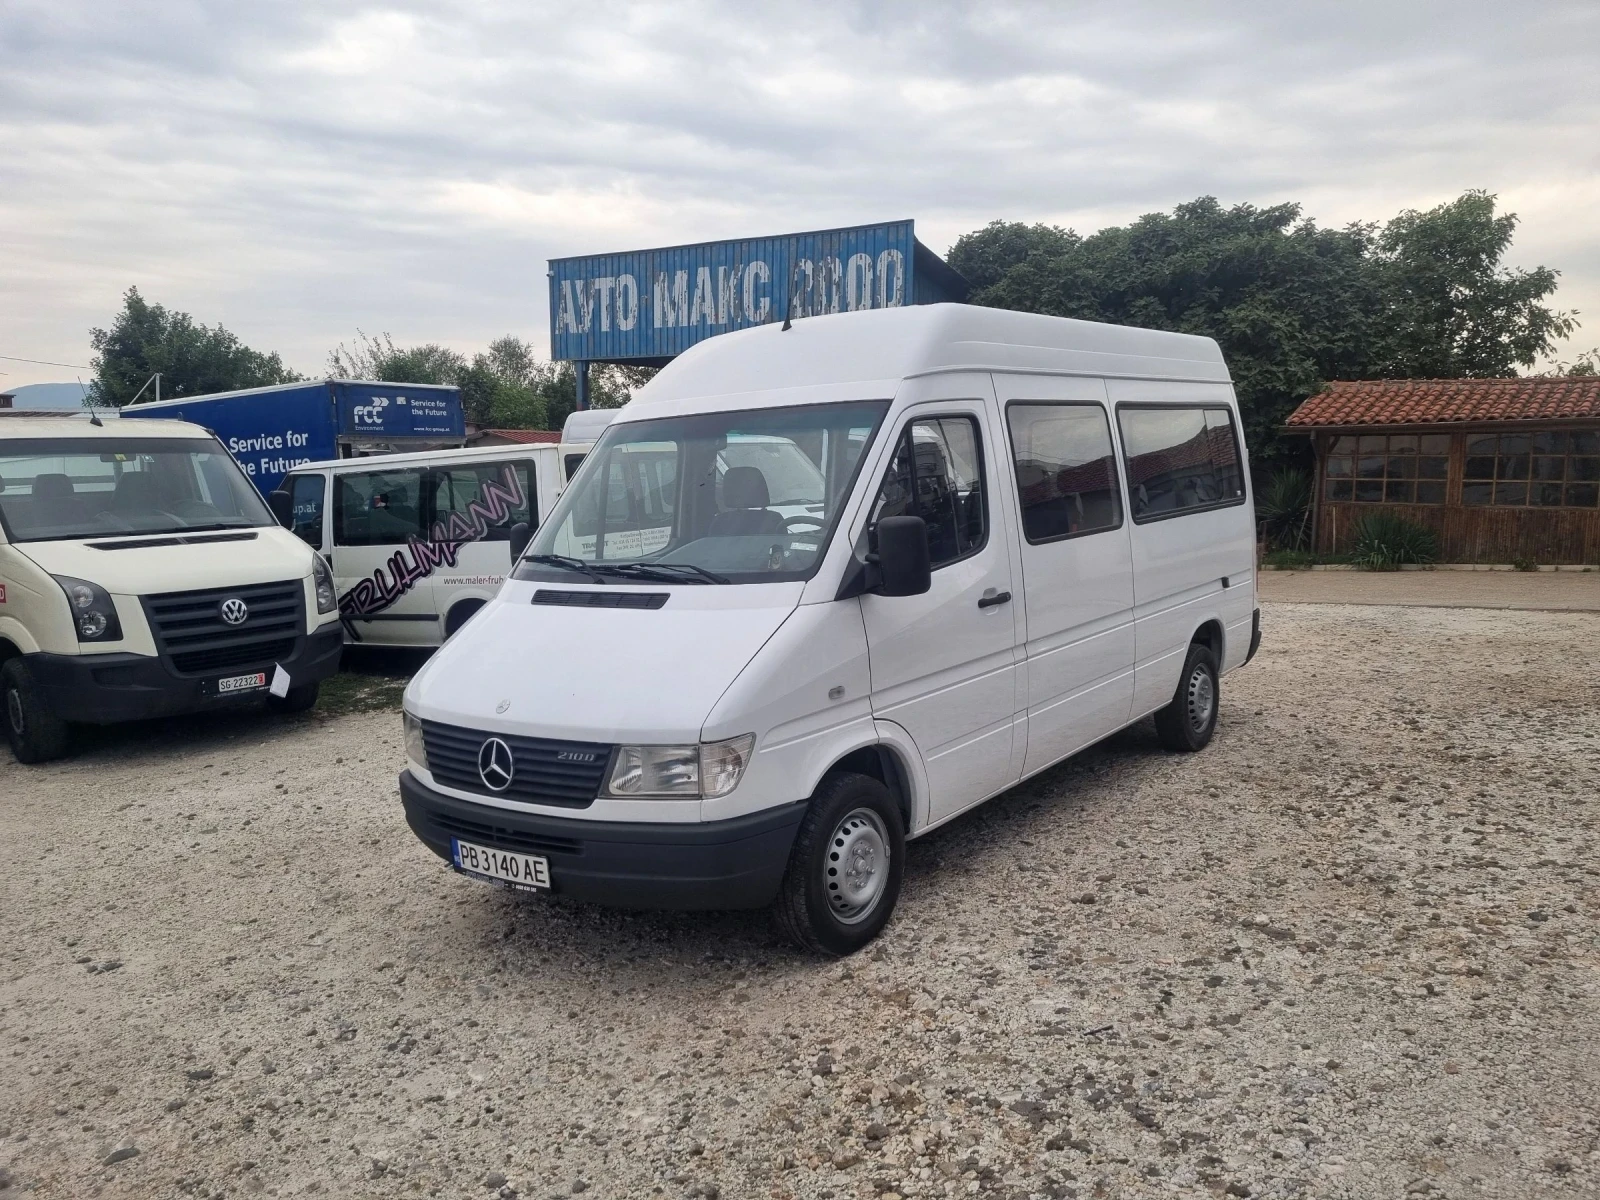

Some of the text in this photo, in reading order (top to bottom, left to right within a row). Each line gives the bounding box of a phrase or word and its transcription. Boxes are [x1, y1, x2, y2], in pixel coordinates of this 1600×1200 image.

[654, 260, 770, 329] МАКС
[792, 249, 905, 319] 2000
[410, 399, 447, 408] Service for
[353, 405, 383, 424] FCC
[411, 408, 424, 416] the
[229, 430, 309, 453] Service for
[237, 460, 256, 475] he
[292, 502, 316, 515] up.at
[443, 575, 504, 585] www.maler-fruh
[524, 858, 546, 884] AE
